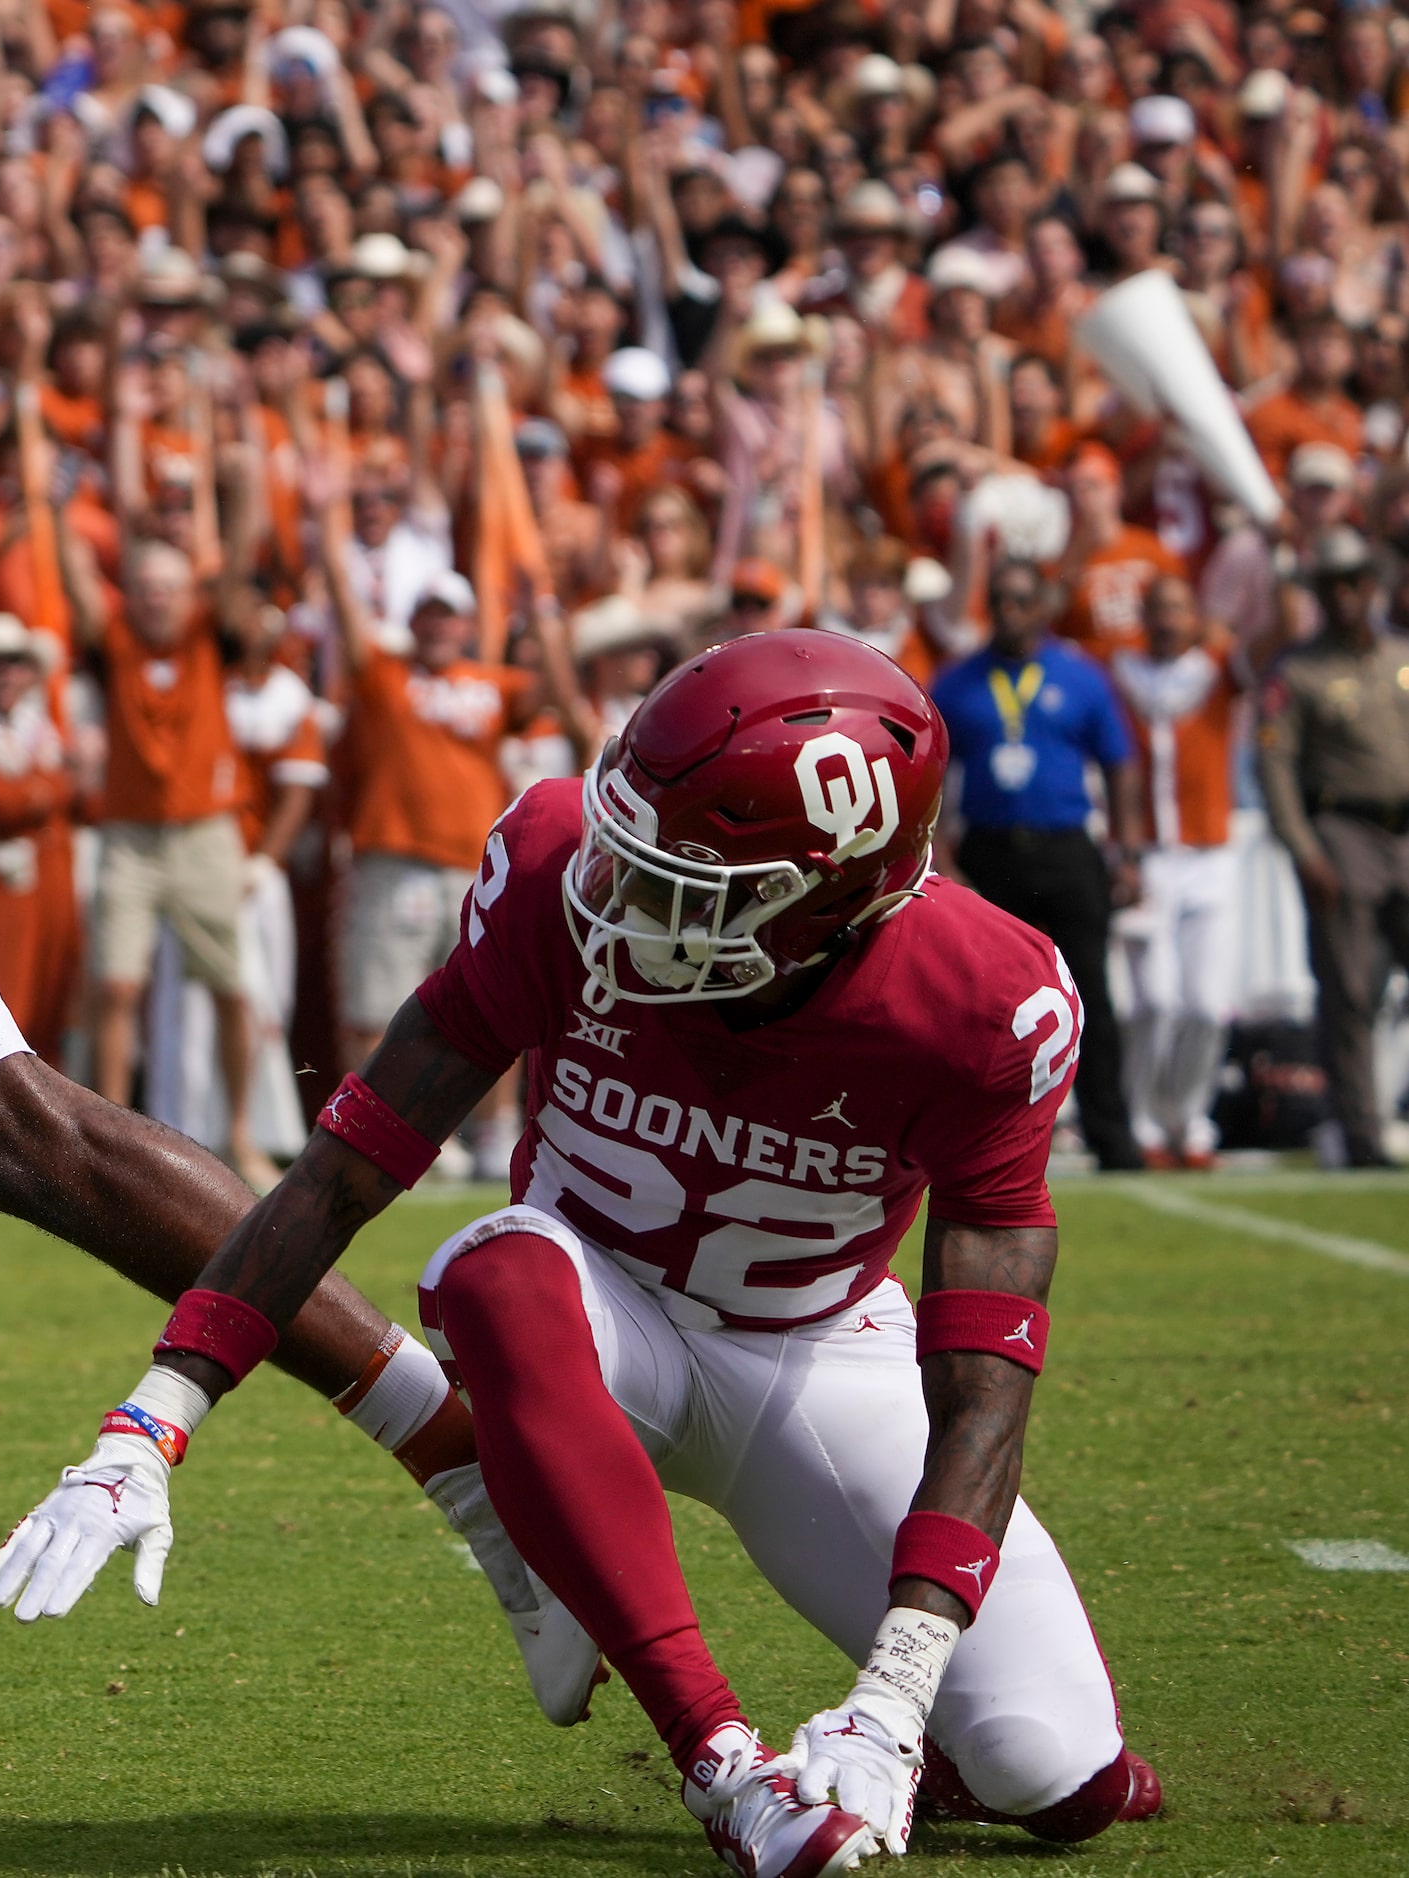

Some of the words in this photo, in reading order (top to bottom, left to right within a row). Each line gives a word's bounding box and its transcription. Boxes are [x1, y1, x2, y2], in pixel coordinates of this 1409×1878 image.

[793, 731, 900, 859] OU
[566, 1010, 632, 1059] XII
[553, 1057, 887, 1186] SOONERS
[522, 1100, 885, 1319] 22
